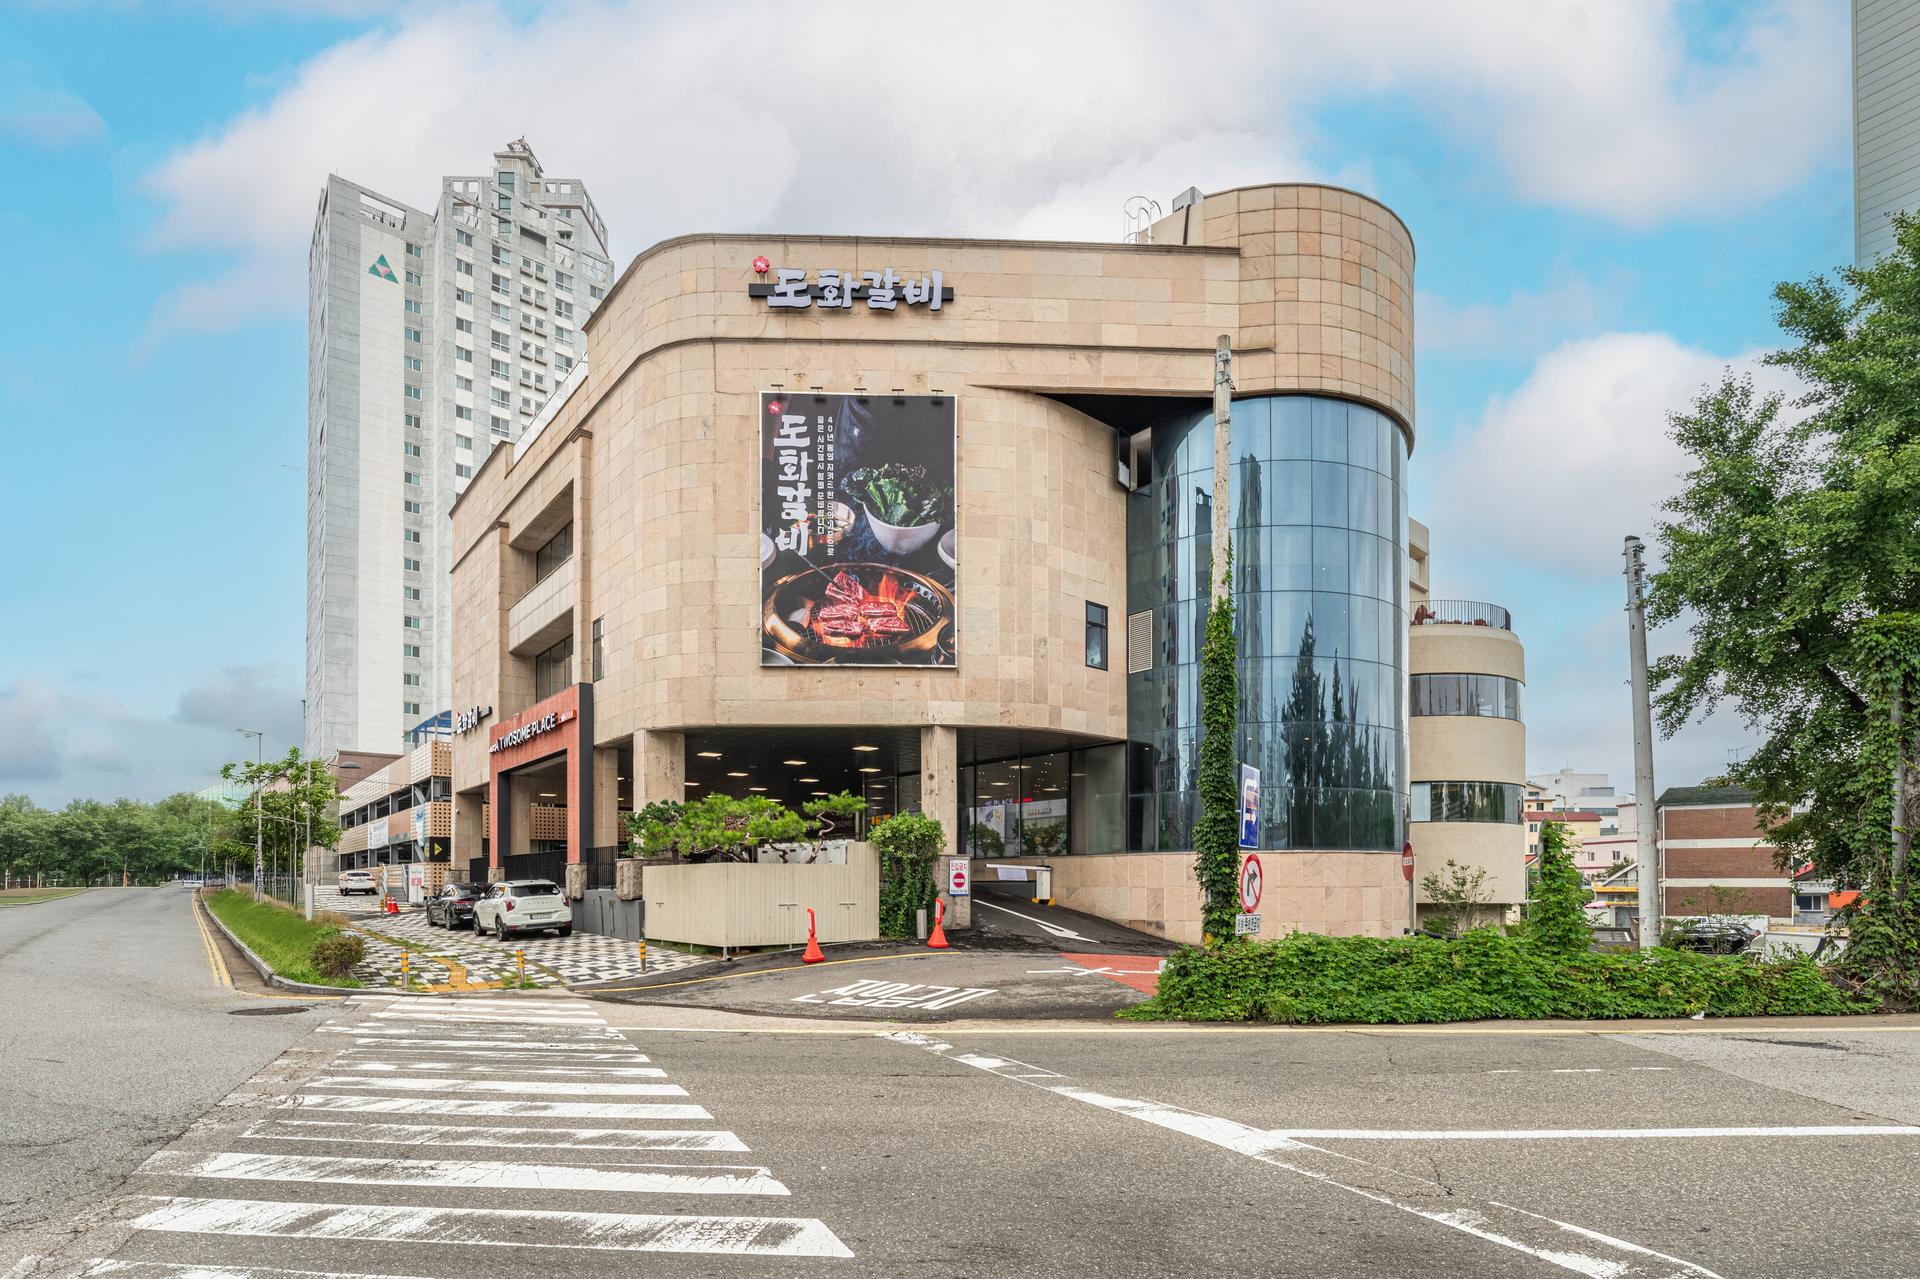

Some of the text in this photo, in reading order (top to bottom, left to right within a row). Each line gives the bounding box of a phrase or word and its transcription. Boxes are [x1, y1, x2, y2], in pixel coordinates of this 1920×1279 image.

[767, 267, 943, 311] 도화갈비
[773, 414, 814, 556] 도화갈비
[499, 724, 531, 751] TWOSOME
[531, 713, 556, 737] PLACE
